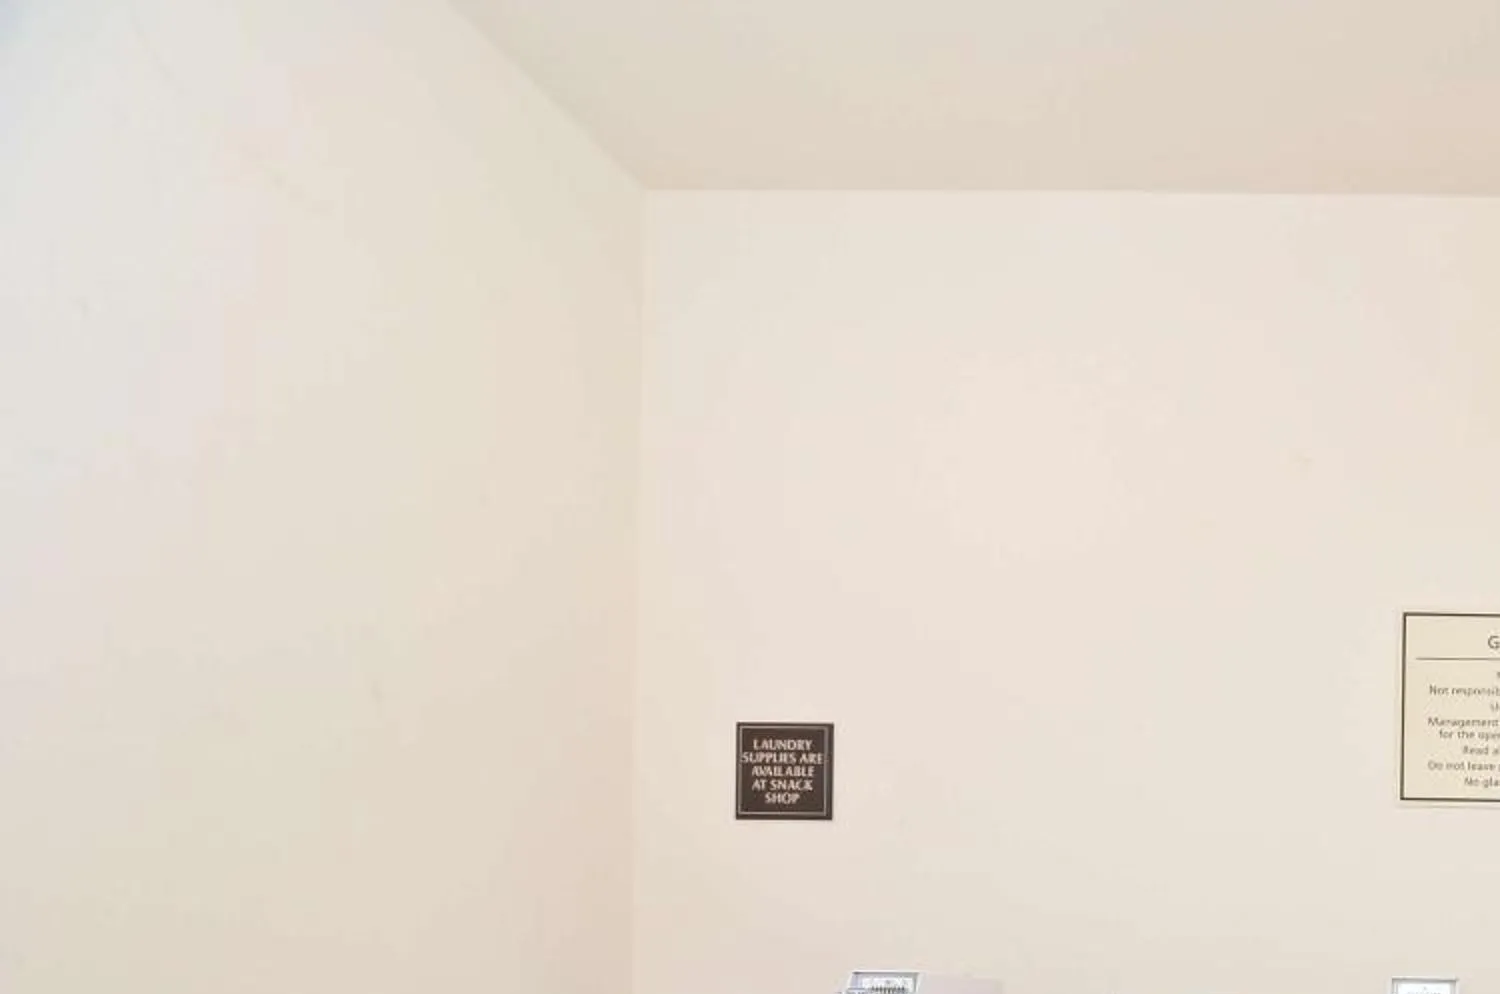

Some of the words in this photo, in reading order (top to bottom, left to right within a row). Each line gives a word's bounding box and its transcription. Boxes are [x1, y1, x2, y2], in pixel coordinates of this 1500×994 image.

[753, 739, 813, 750] LAUNDRY
[741, 752, 797, 764] SUPPLIES
[799, 752, 824, 764] ARE
[751, 765, 815, 777] AVAILABLE
[751, 779, 767, 791] AT
[769, 779, 814, 791] SNACK
[764, 792, 800, 804] SHOP
